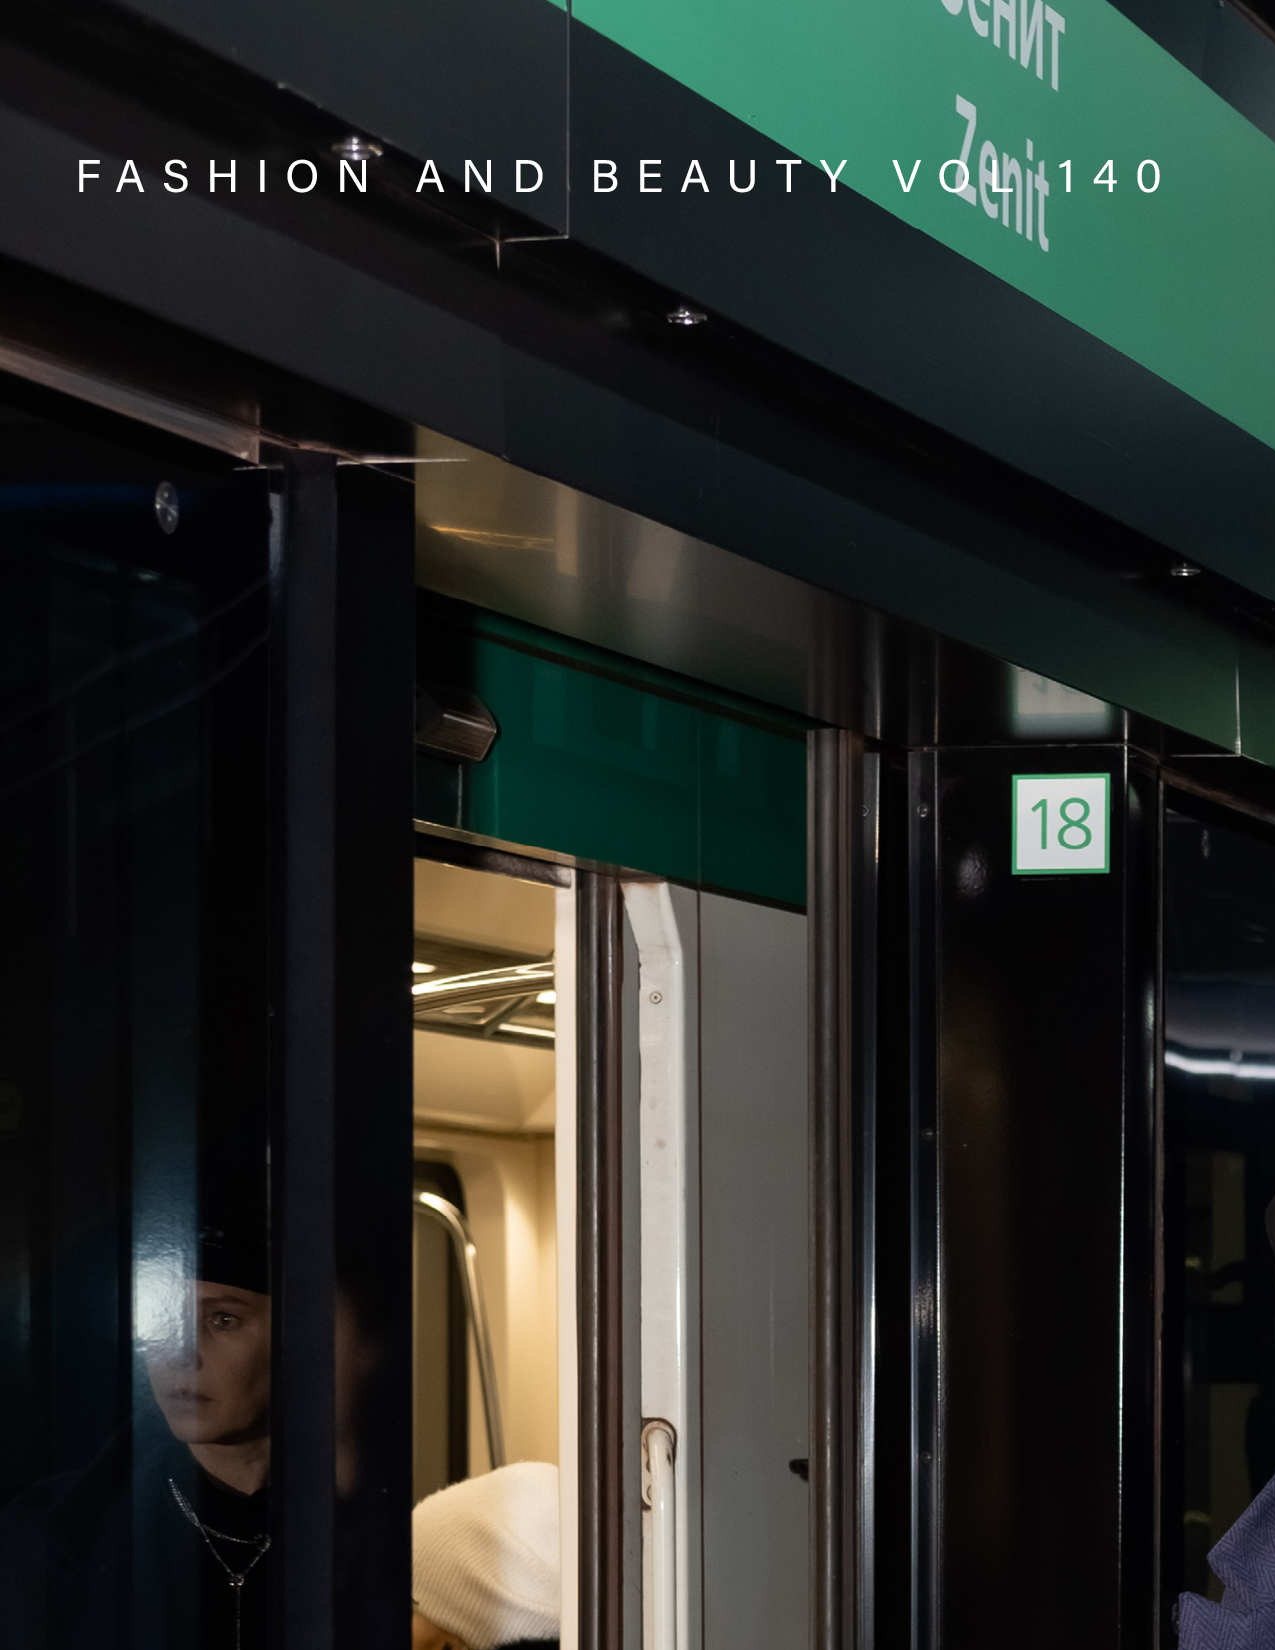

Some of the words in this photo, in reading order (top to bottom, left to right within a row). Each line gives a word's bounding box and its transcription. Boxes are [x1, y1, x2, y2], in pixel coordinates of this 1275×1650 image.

[941, 0, 1066, 92] енит
[955, 94, 1049, 252] Zenit
[1031, 797, 1092, 850] 18
